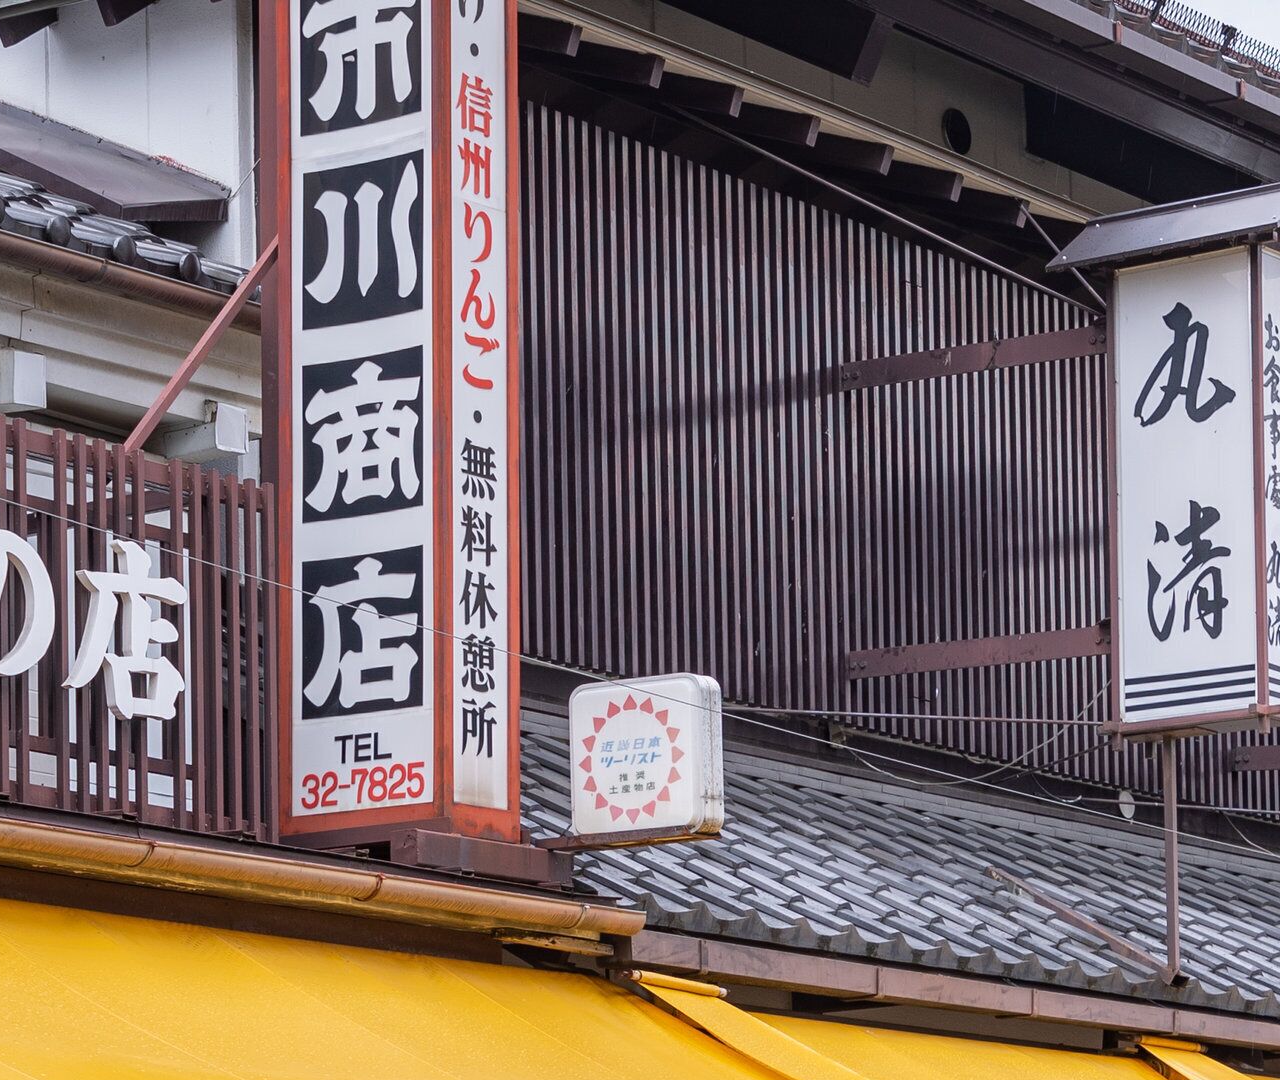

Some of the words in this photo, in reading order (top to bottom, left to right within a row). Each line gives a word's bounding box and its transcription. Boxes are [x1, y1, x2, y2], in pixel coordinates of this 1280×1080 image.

[1134, 302, 1236, 641] 丸清
[334, 731, 393, 764] TEL
[601, 736, 662, 753] 近畿日本
[600, 751, 662, 768] ツーリスト
[619, 771, 645, 781] 推奨
[301, 761, 425, 811] 32-7825
[608, 781, 656, 795] 土産物店
